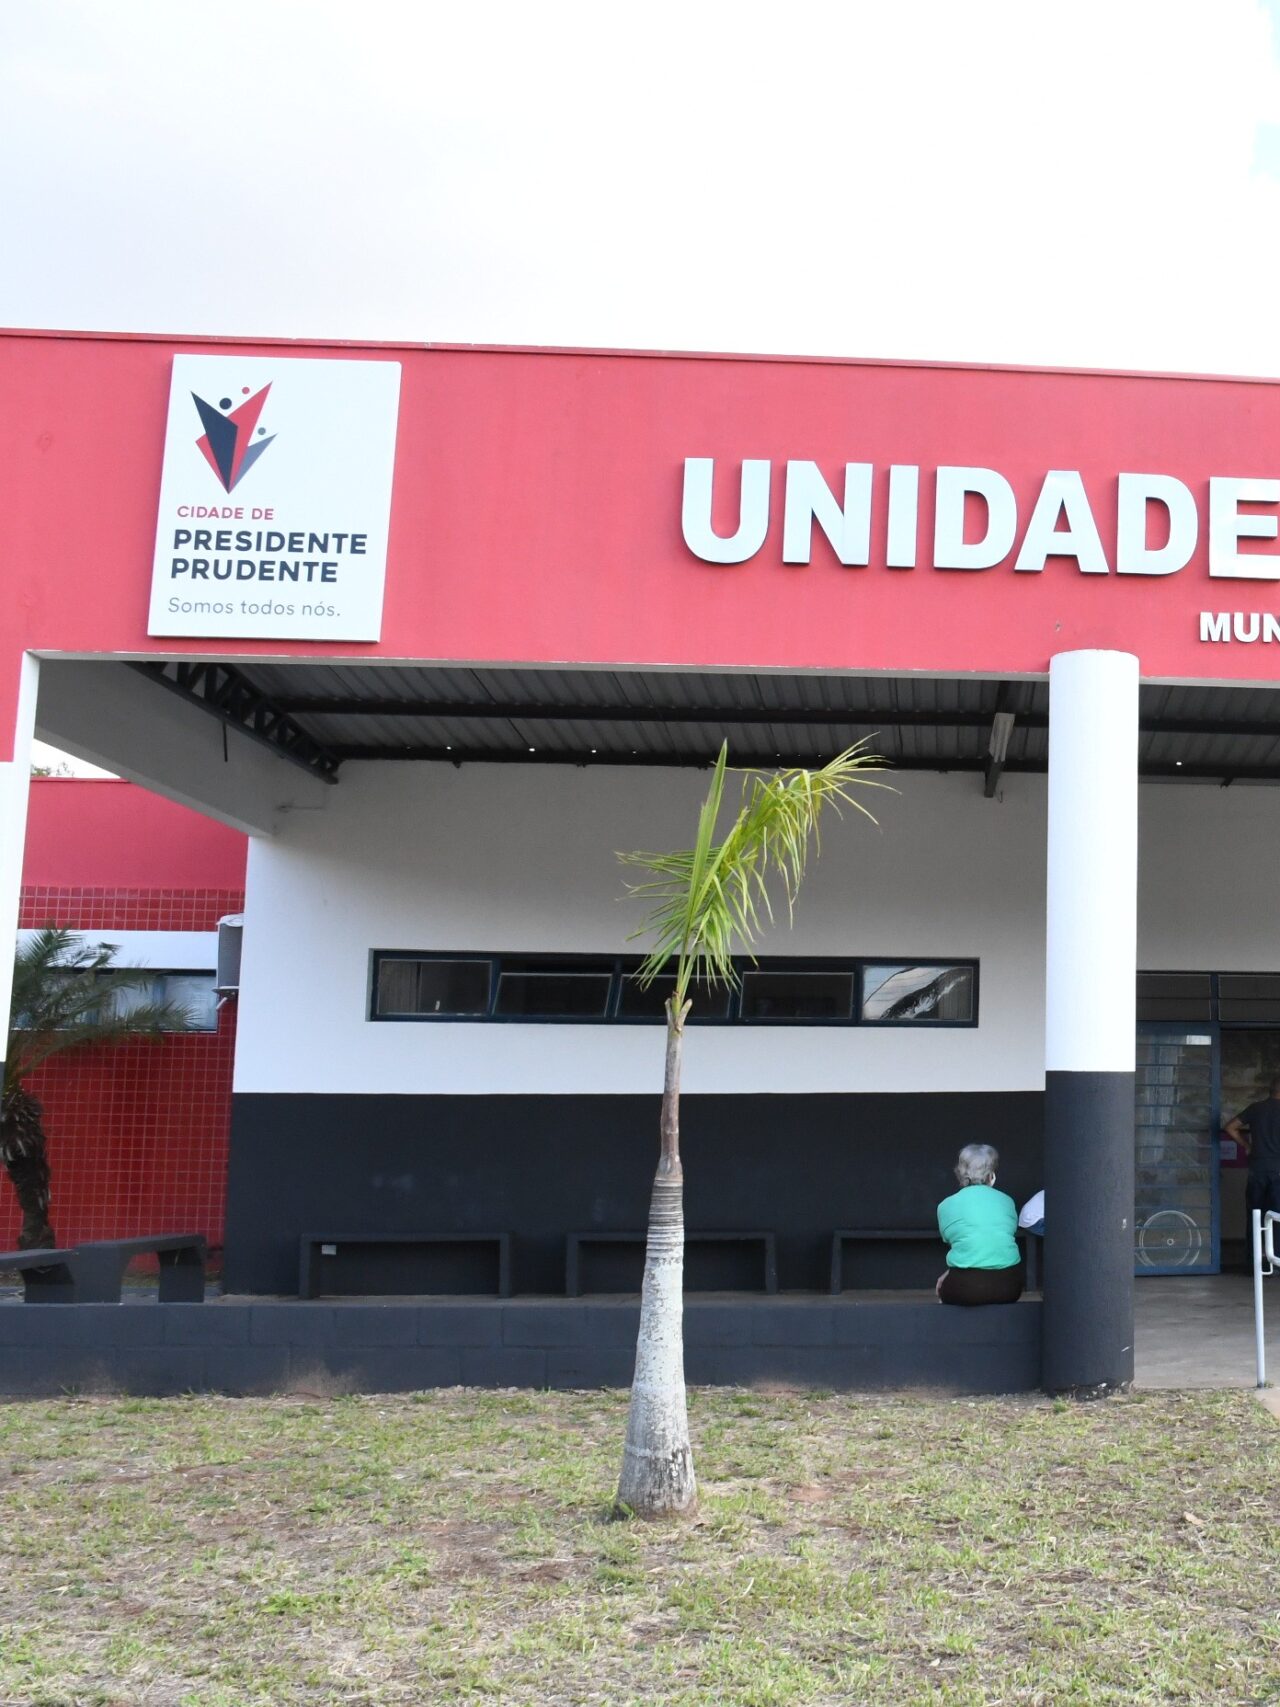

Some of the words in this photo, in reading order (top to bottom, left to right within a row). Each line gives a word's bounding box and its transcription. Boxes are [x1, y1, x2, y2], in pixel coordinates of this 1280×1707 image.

[177, 505, 244, 519] CIDADE
[252, 507, 275, 520] DE
[173, 529, 368, 555] PRESIDENTE
[171, 557, 339, 583] PRUDENTE
[167, 596, 234, 615] Somos
[240, 599, 295, 616] todos
[301, 600, 342, 617] nós.
